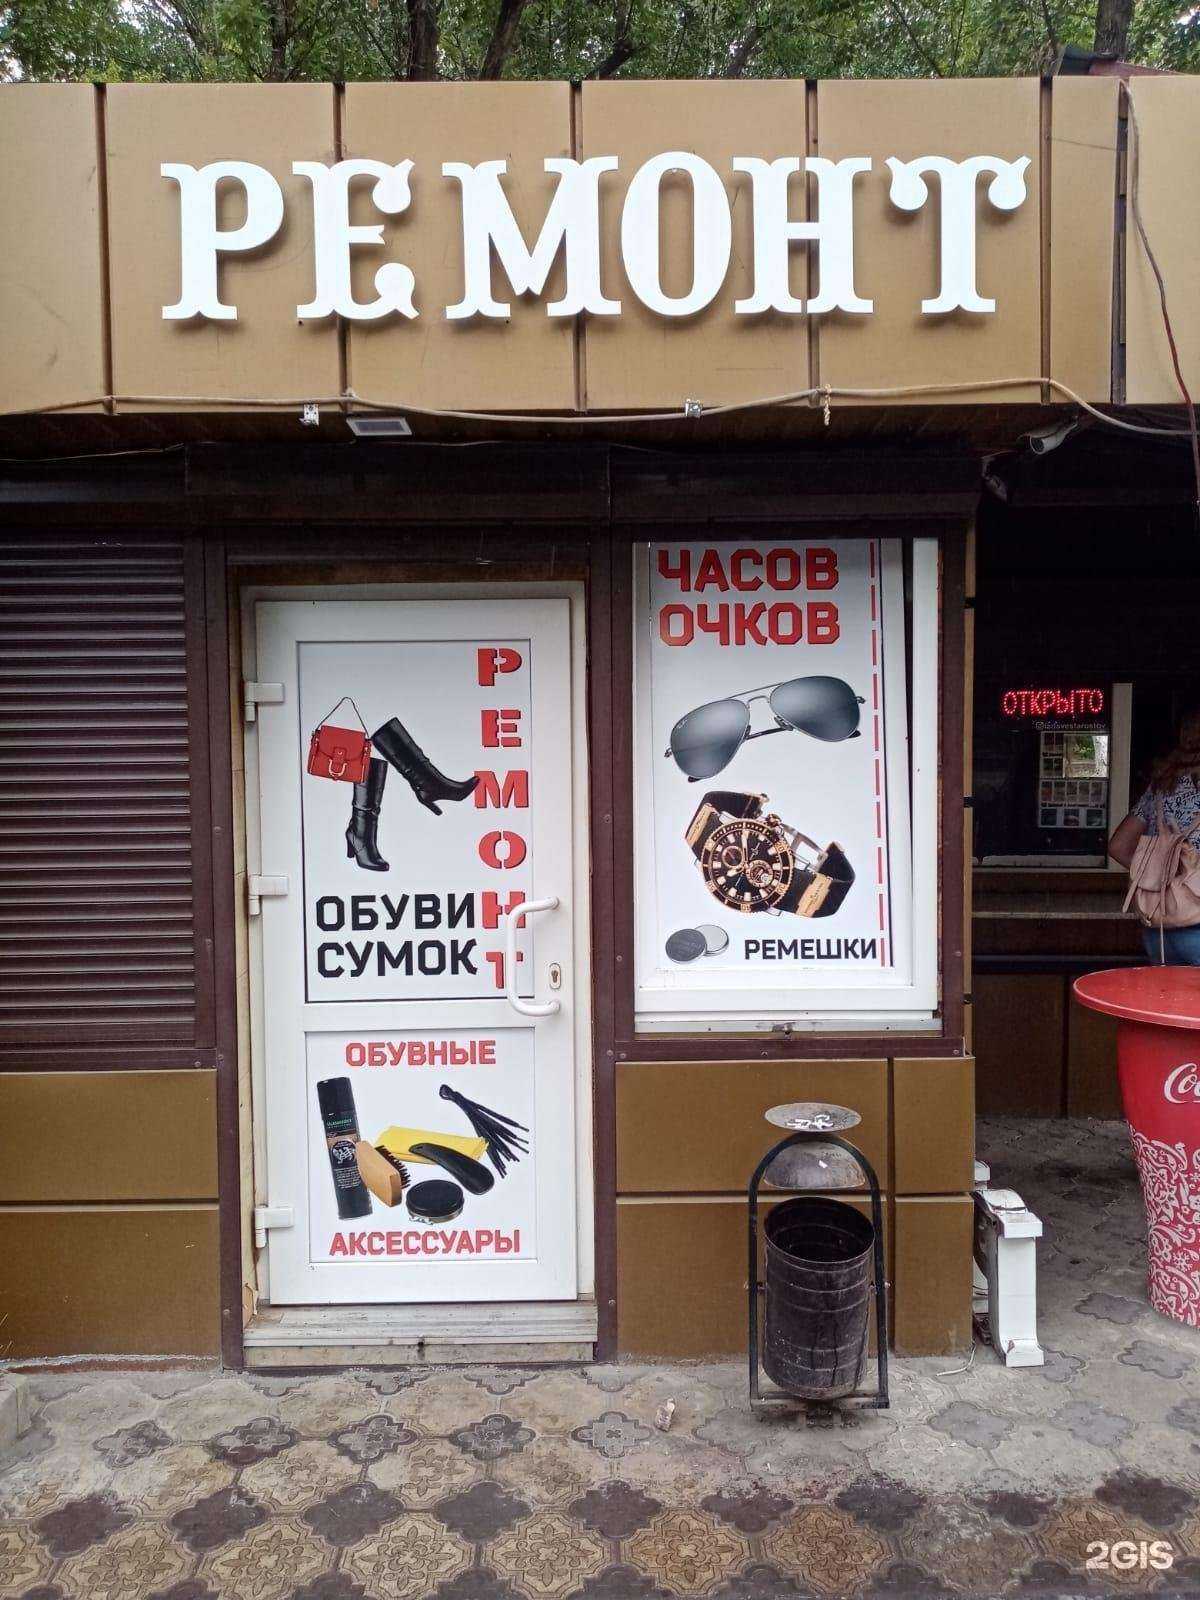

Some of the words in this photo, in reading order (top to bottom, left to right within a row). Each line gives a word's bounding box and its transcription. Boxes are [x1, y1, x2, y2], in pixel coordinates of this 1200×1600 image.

[161, 151, 1031, 320] РЕМОНТ
[658, 548, 839, 592] ЧАСОВ
[658, 602, 841, 648] ОЧКОВ
[1003, 689, 1104, 715] ОТКРЫТО
[474, 648, 529, 989] РЕМОНТ
[316, 893, 475, 932] ОБУВИ
[317, 939, 478, 978] СУМОК
[744, 937, 877, 960] РЕМЕШКИ
[345, 1040, 497, 1067] ОБУВНЫЕ
[329, 1229, 521, 1256] АКСЕССУАРЫ
